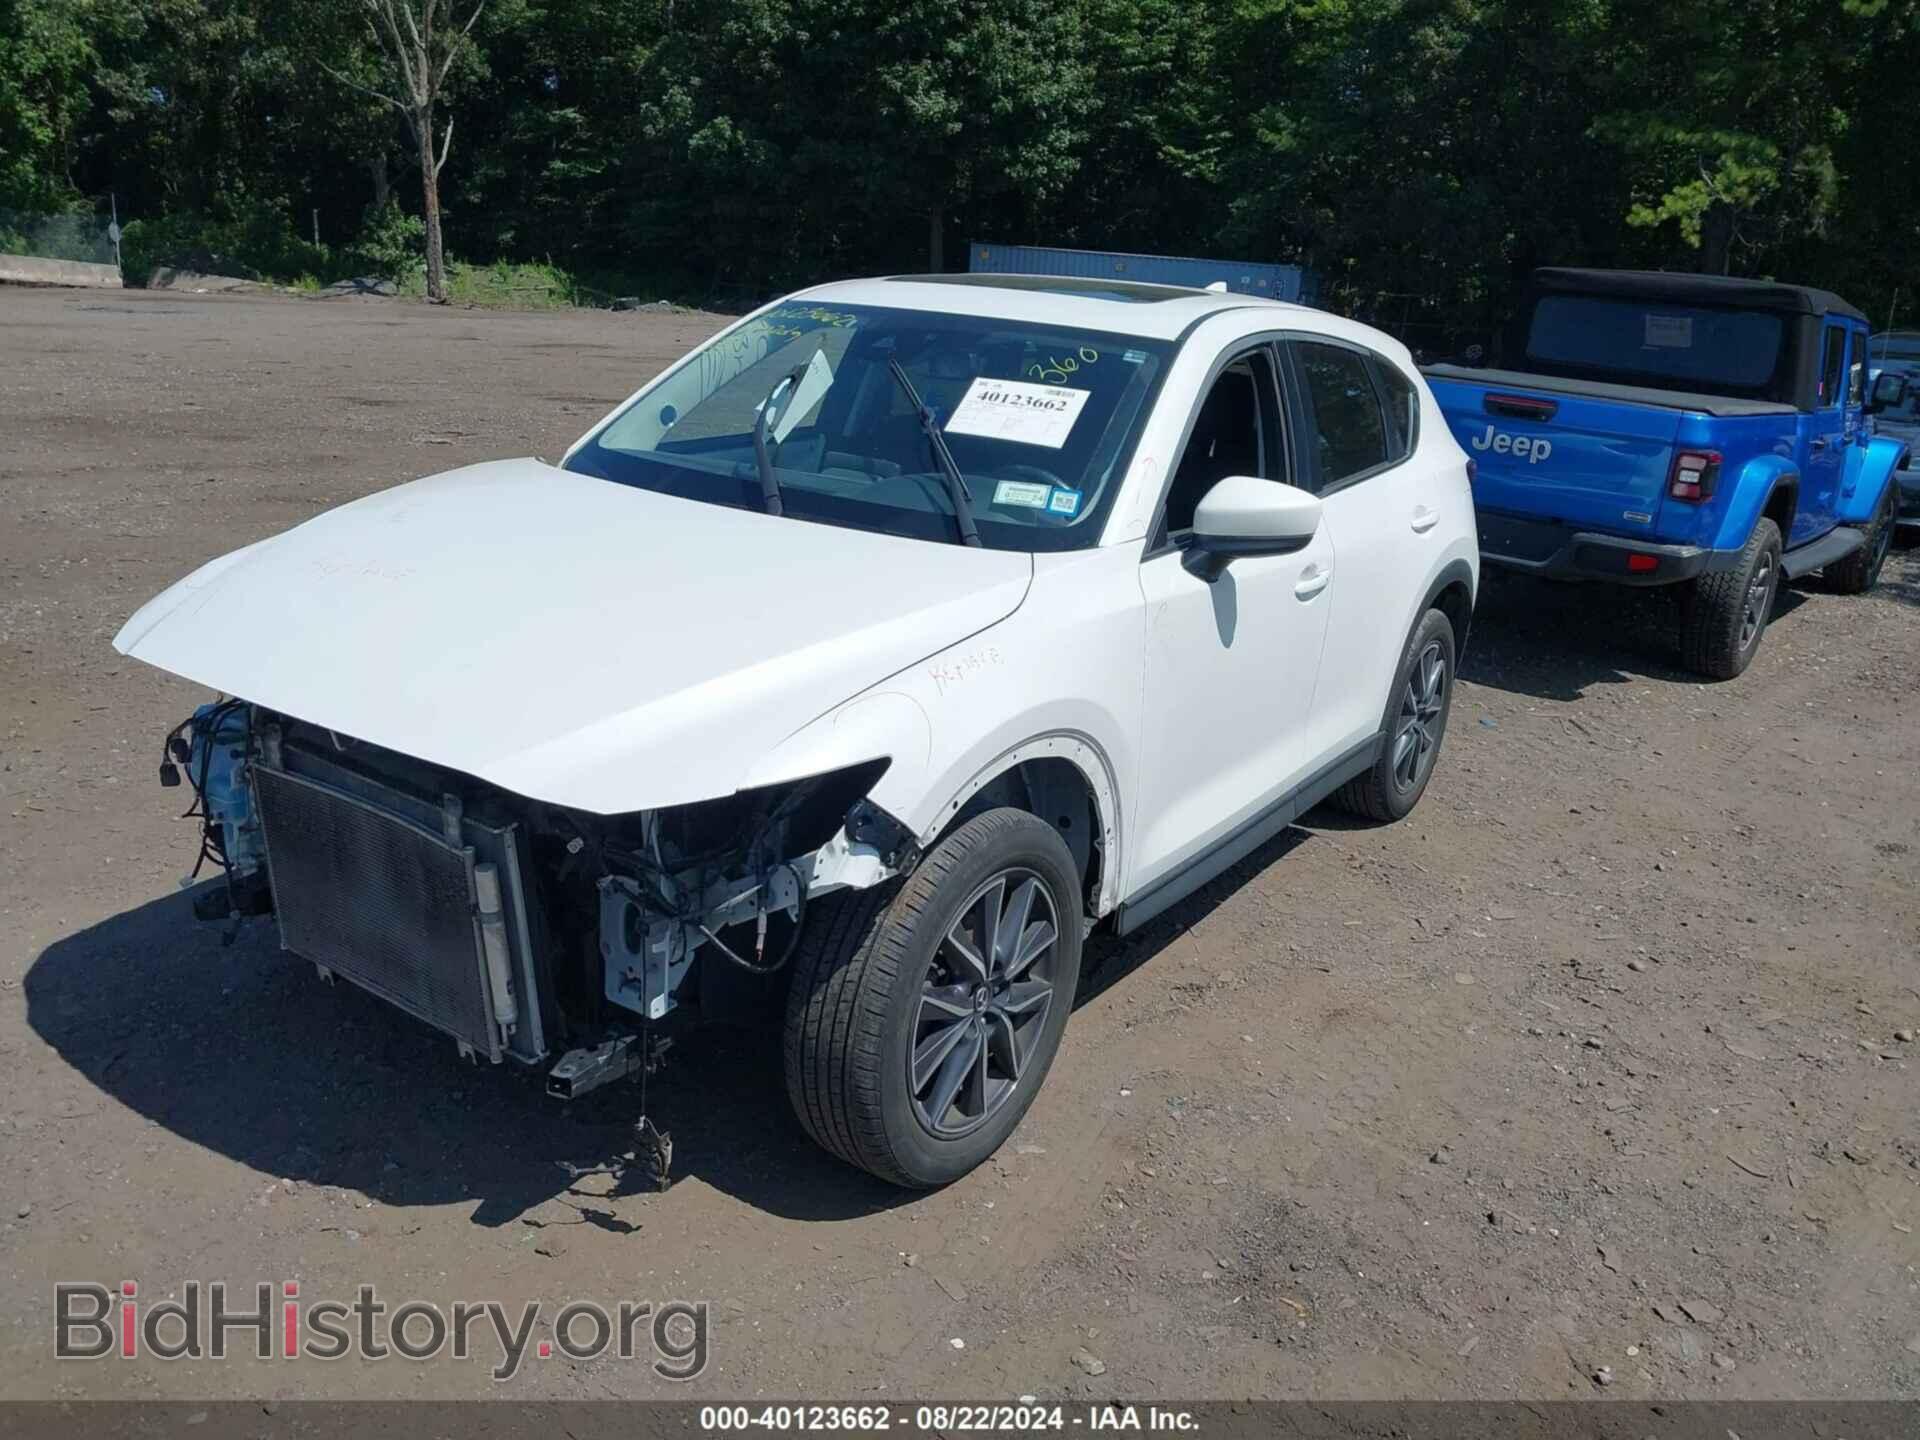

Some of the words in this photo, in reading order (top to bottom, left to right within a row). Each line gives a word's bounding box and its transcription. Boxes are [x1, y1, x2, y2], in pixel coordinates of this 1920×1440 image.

[1027, 344, 1099, 385] 360
[976, 388, 1068, 413] 40123662
[1471, 424, 1553, 465] Jeep
